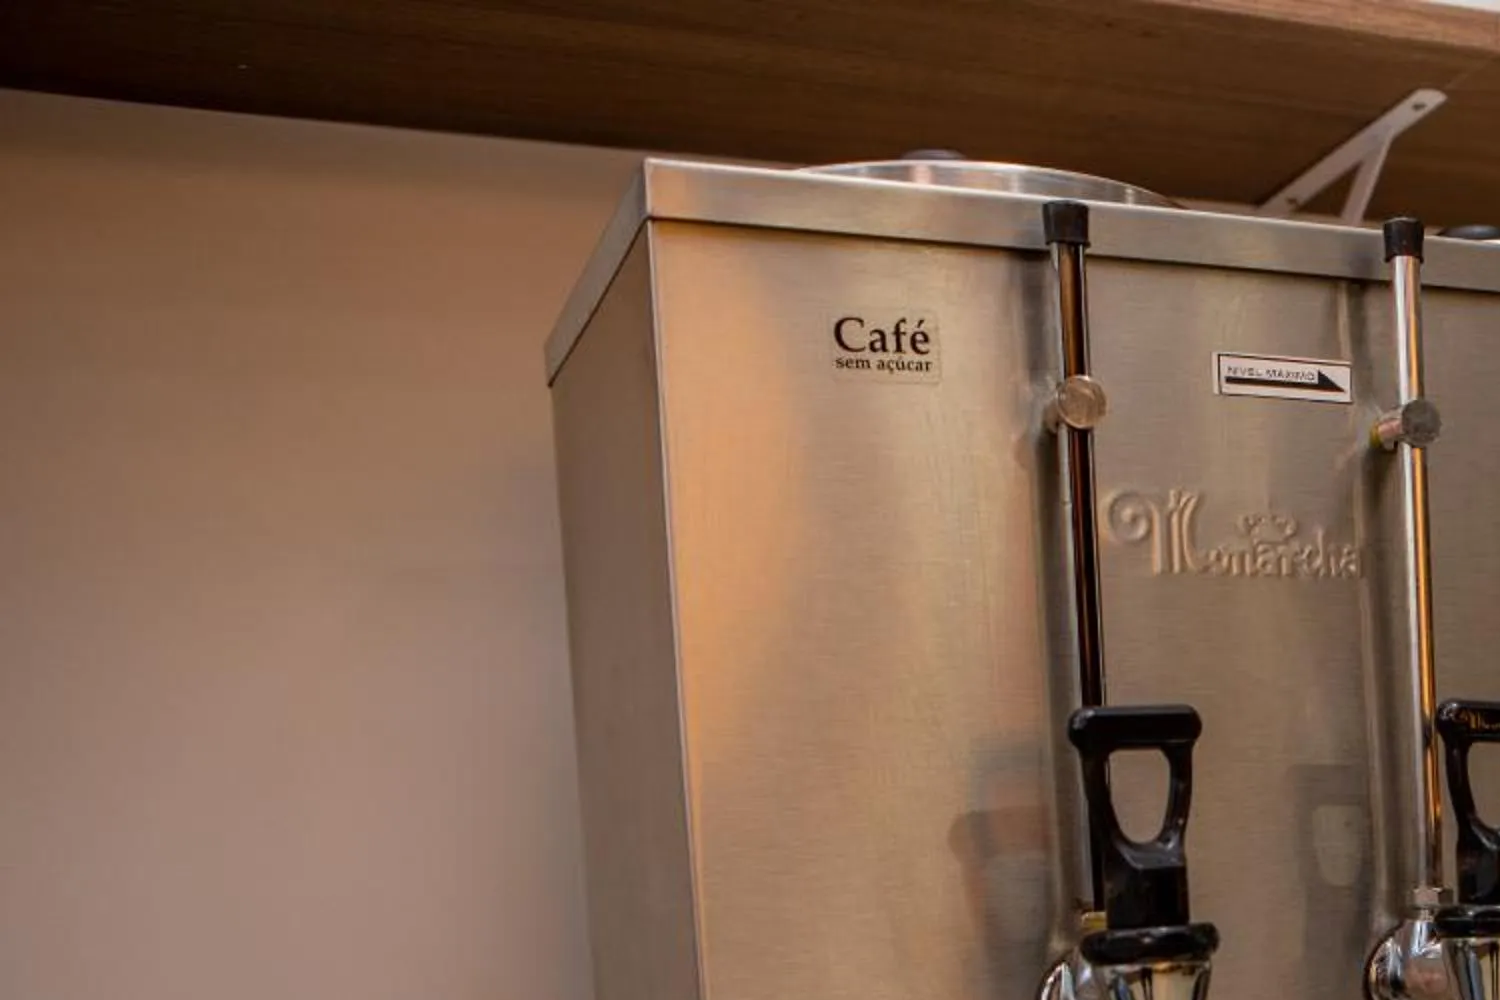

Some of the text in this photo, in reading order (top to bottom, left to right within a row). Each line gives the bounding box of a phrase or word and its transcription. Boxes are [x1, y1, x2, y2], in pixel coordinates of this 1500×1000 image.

[834, 316, 930, 355] Café
[835, 355, 933, 374] sem açúcar
